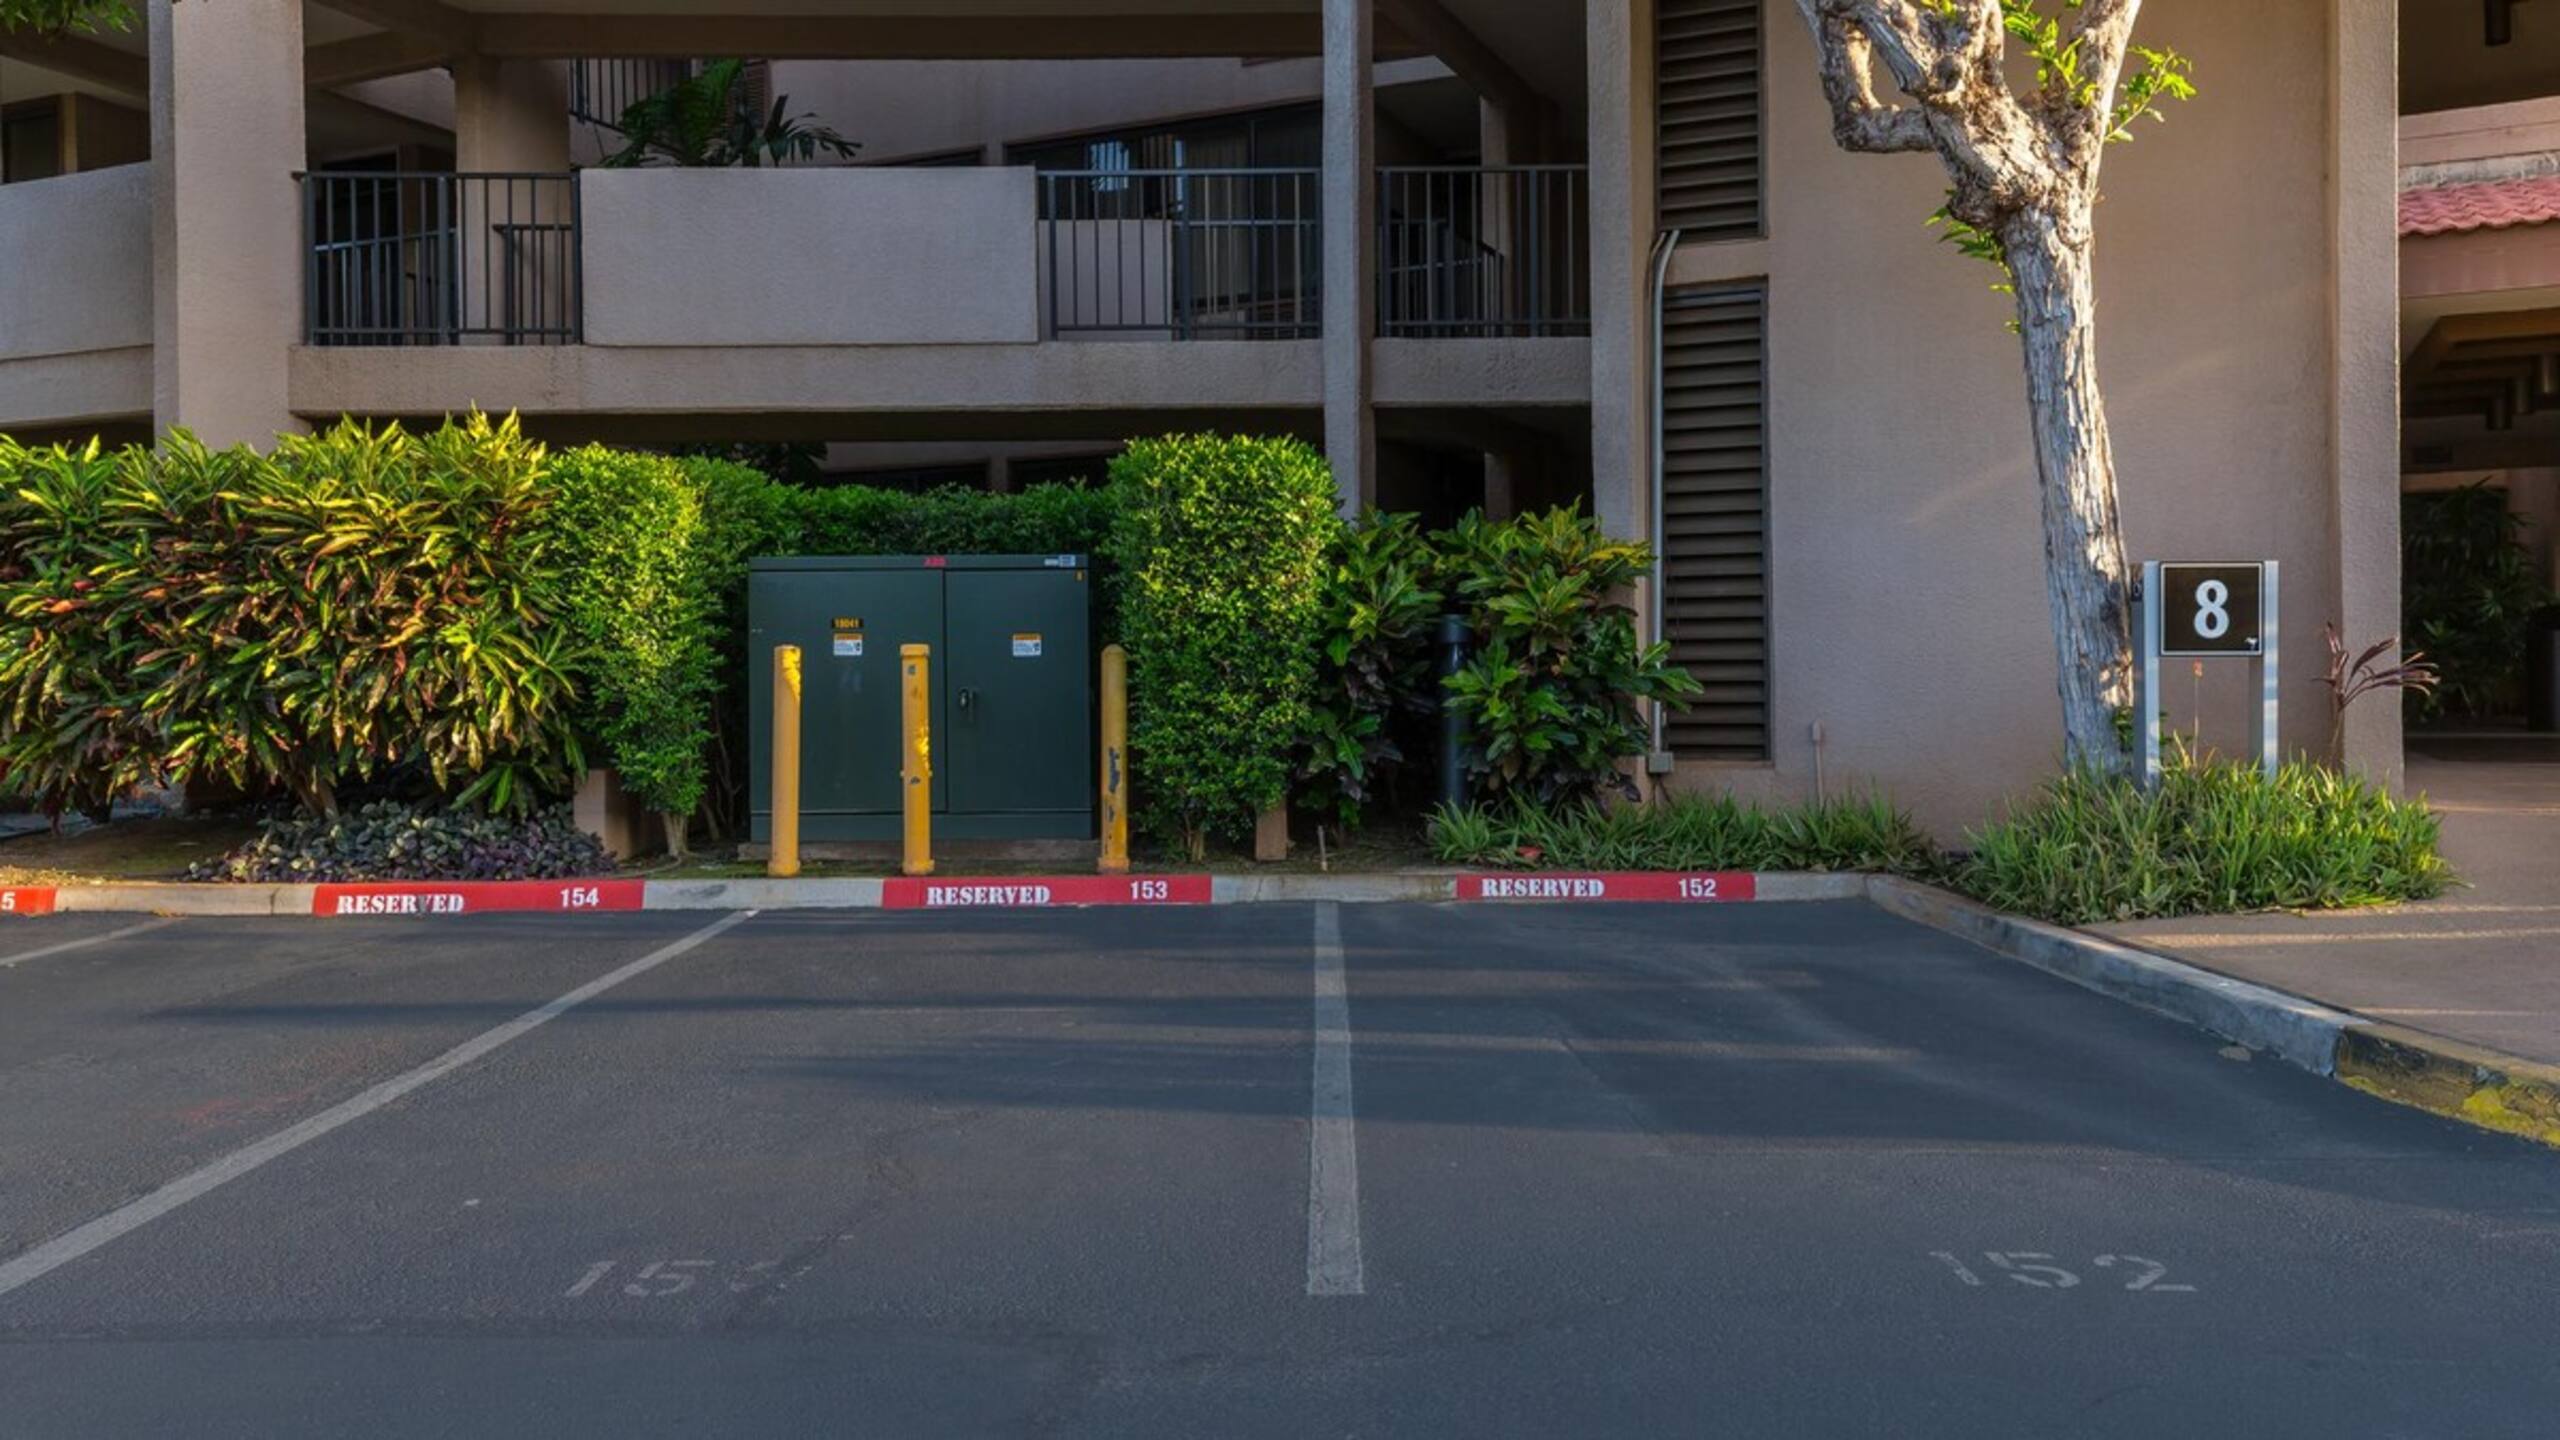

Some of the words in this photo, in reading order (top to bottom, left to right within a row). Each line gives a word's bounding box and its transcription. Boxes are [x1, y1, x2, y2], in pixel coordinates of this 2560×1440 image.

[2194, 579, 2230, 639] 8
[336, 894, 465, 914] RESERVED
[560, 887, 600, 907] 154
[926, 885, 1051, 906] RESERVED
[1130, 880, 1169, 900] 153
[1482, 878, 1605, 897] RESERVED
[1678, 878, 1717, 897] 152
[1928, 1251, 2198, 1292] 152
